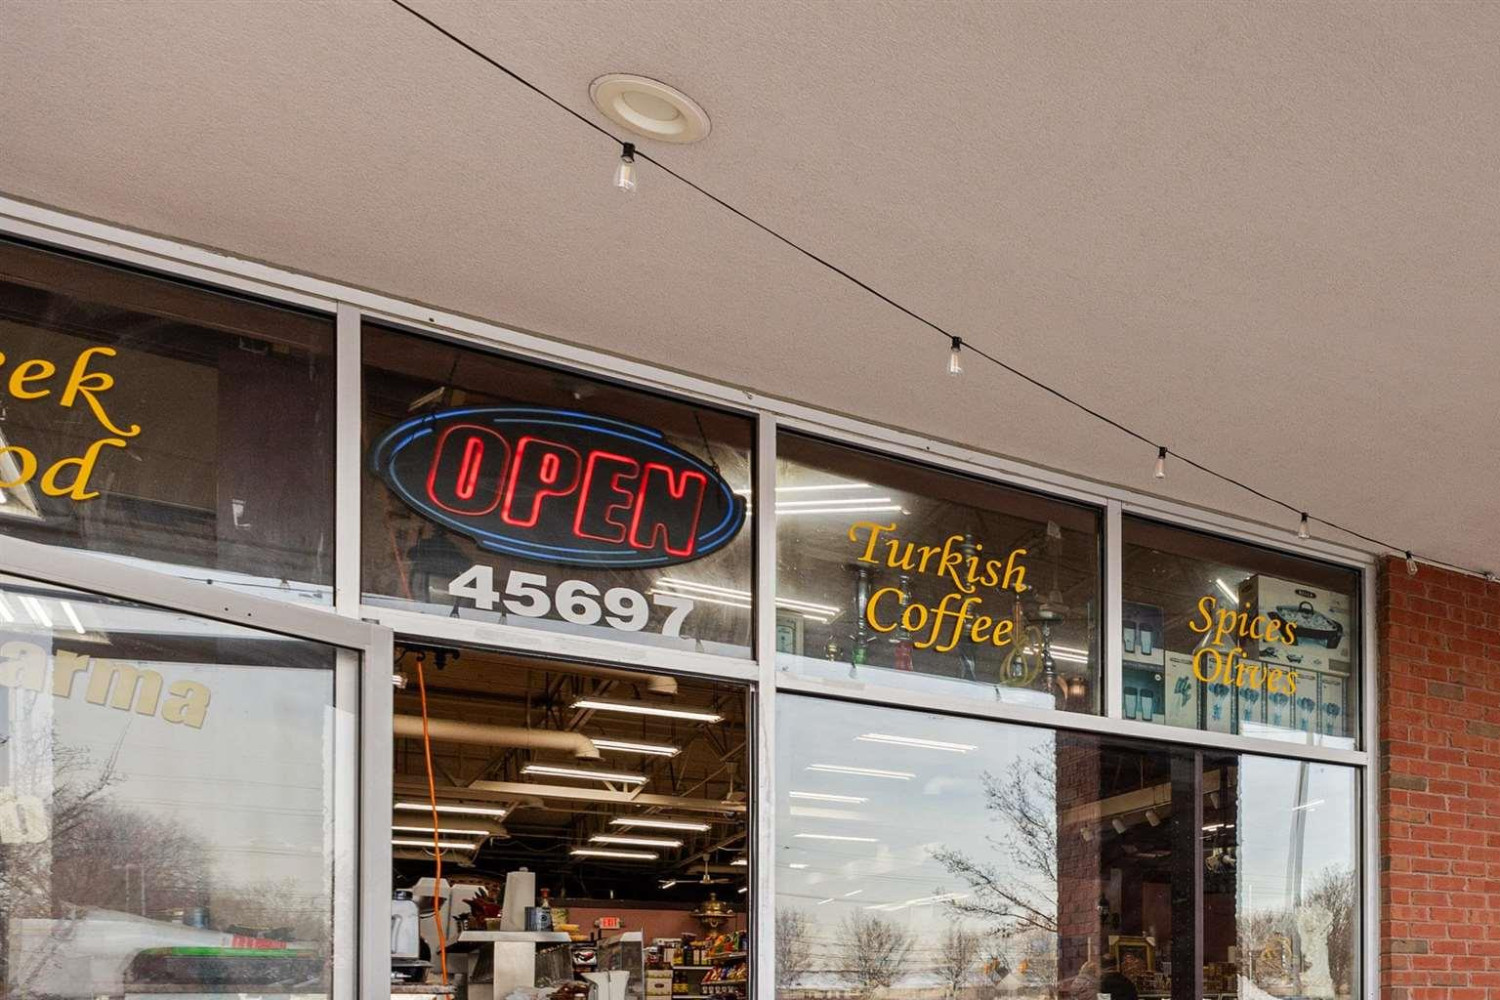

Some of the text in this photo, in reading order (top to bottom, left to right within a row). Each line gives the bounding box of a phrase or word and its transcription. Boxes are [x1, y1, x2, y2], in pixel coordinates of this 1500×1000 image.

[427, 423, 707, 558] OPEN
[848, 520, 1027, 593] Turkish
[448, 564, 696, 638] 45697
[866, 586, 1014, 653] Coffee
[1189, 595, 1299, 647] Spices
[1192, 647, 1300, 695] Olives
